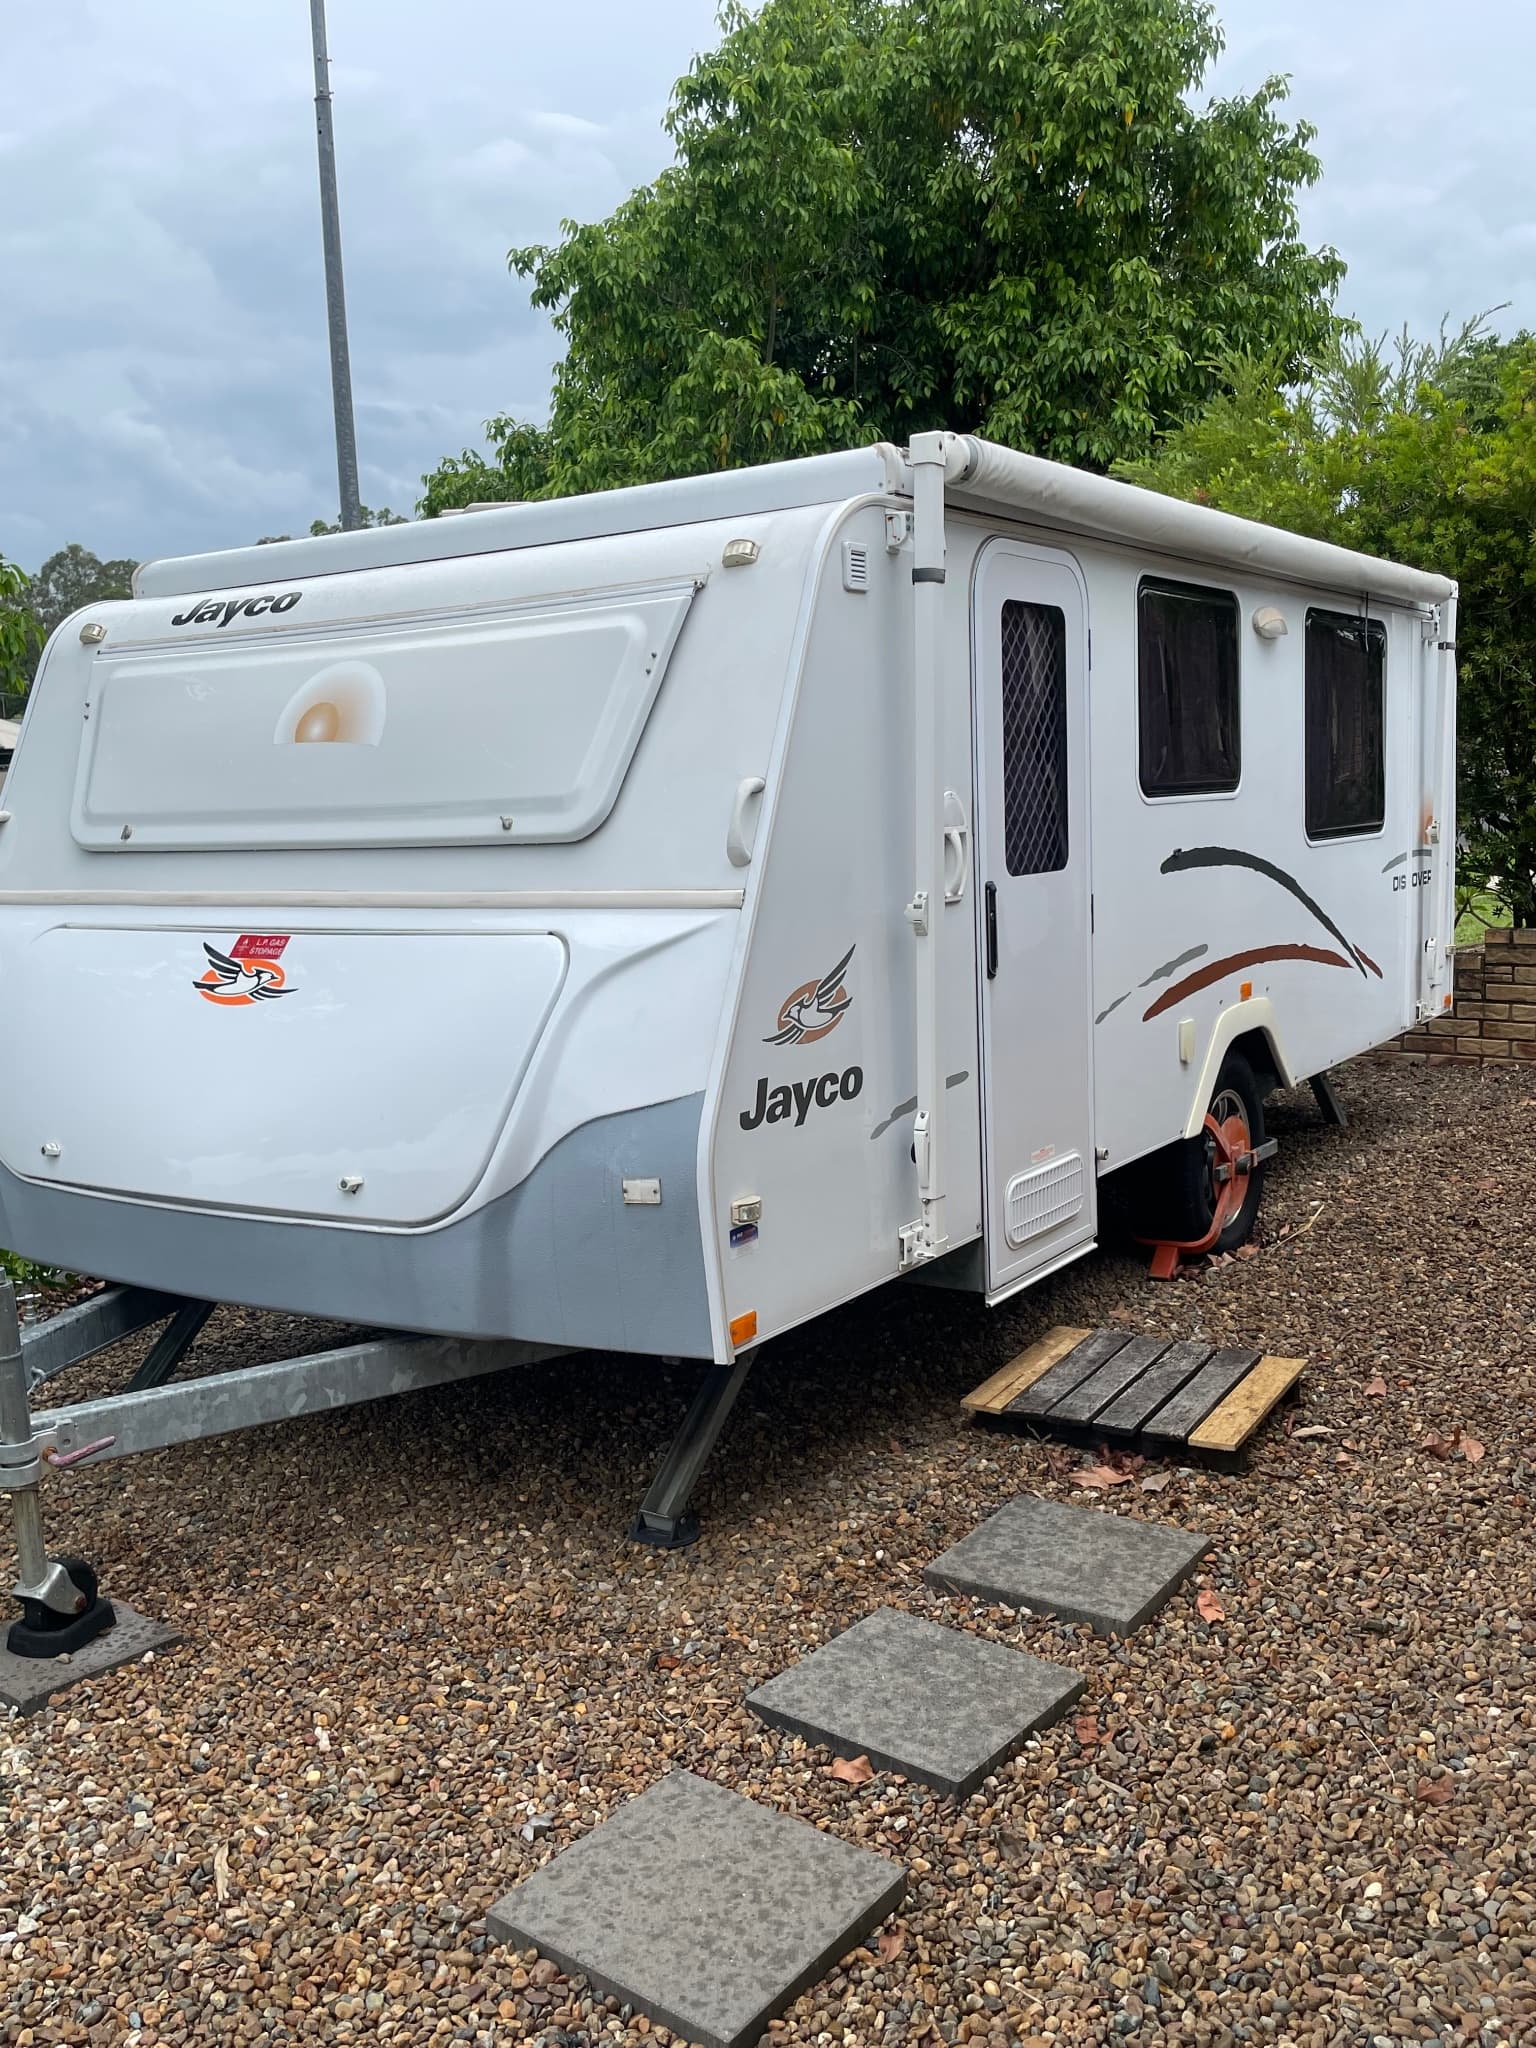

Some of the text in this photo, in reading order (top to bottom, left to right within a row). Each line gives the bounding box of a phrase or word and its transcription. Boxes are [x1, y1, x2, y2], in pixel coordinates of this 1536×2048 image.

[171, 591, 302, 628] Jayco
[269, 938, 286, 947] GAS
[739, 1066, 863, 1131] Jayco
